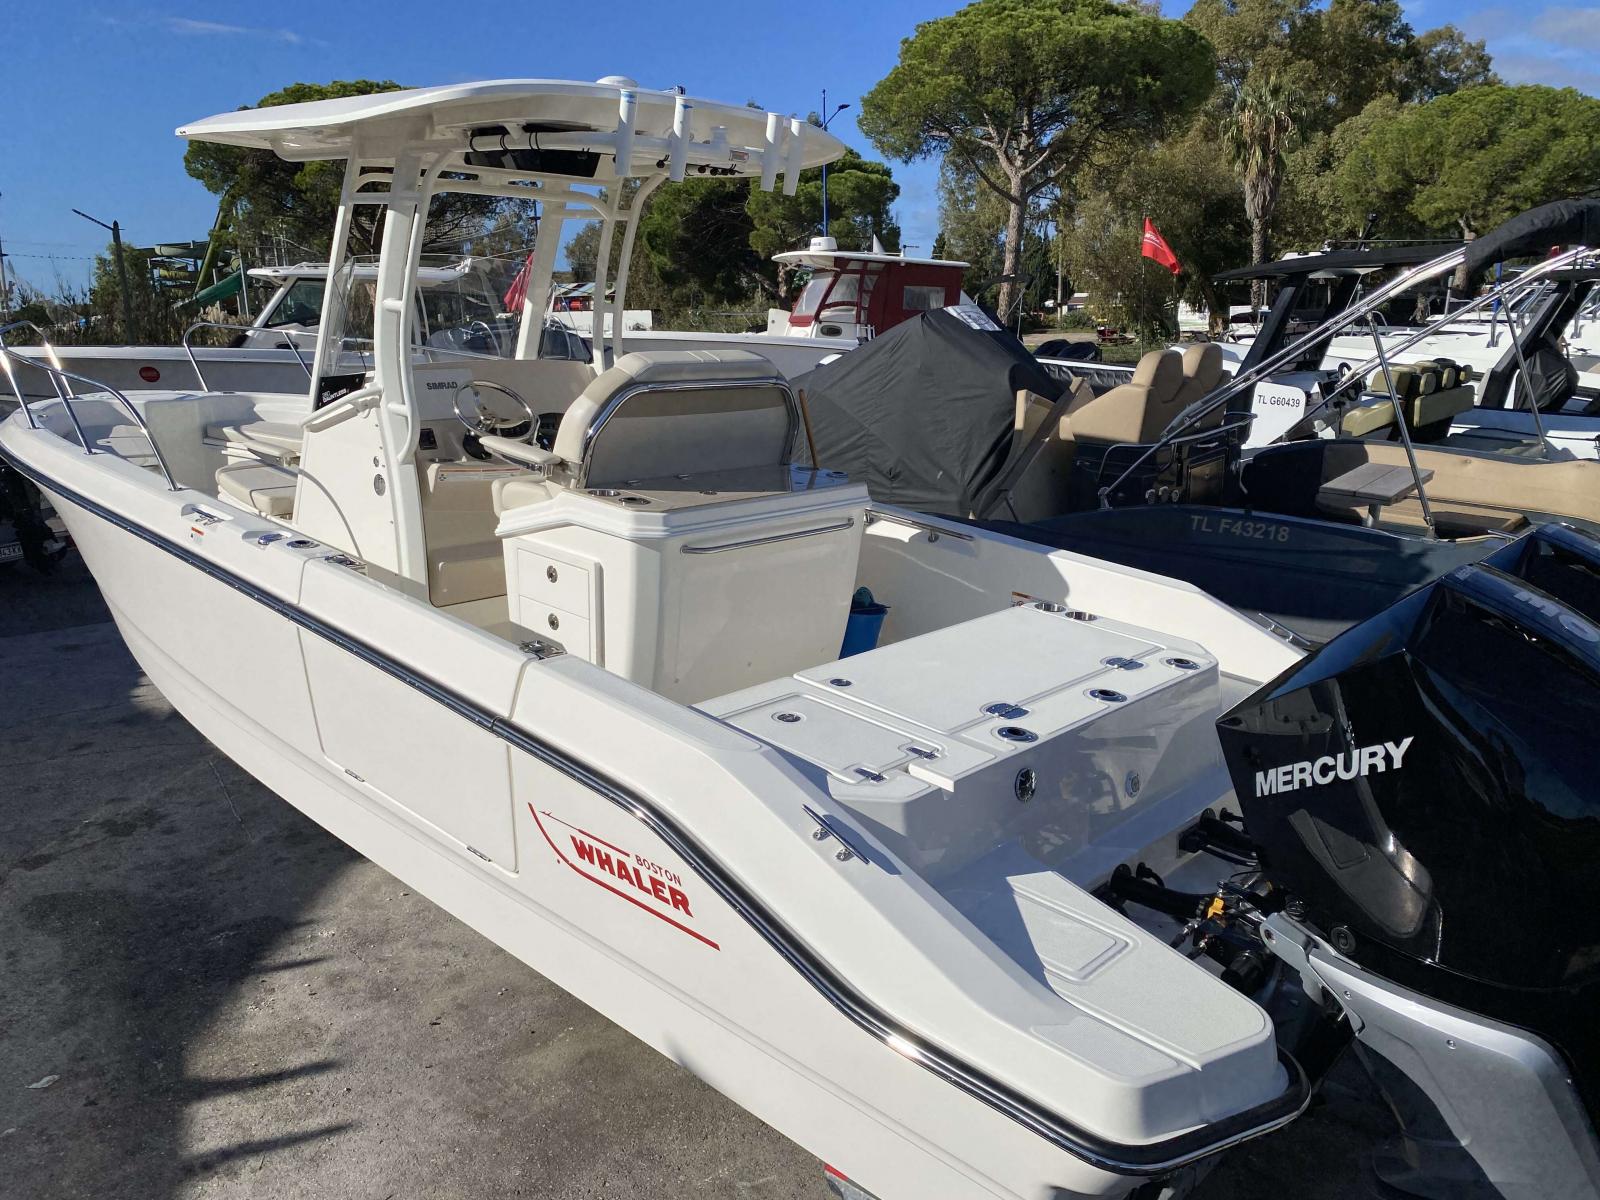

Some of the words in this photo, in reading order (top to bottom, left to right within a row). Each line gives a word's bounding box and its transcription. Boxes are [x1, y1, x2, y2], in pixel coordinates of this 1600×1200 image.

[426, 381, 458, 390] SIMRAD
[1258, 394, 1268, 405] TL
[1269, 396, 1301, 408] G60439
[1191, 514, 1213, 532] TL
[1219, 517, 1290, 542] F43218
[1255, 735, 1415, 798] MERCURY
[569, 834, 694, 918] WHALER
[634, 854, 682, 887] BOSTON
